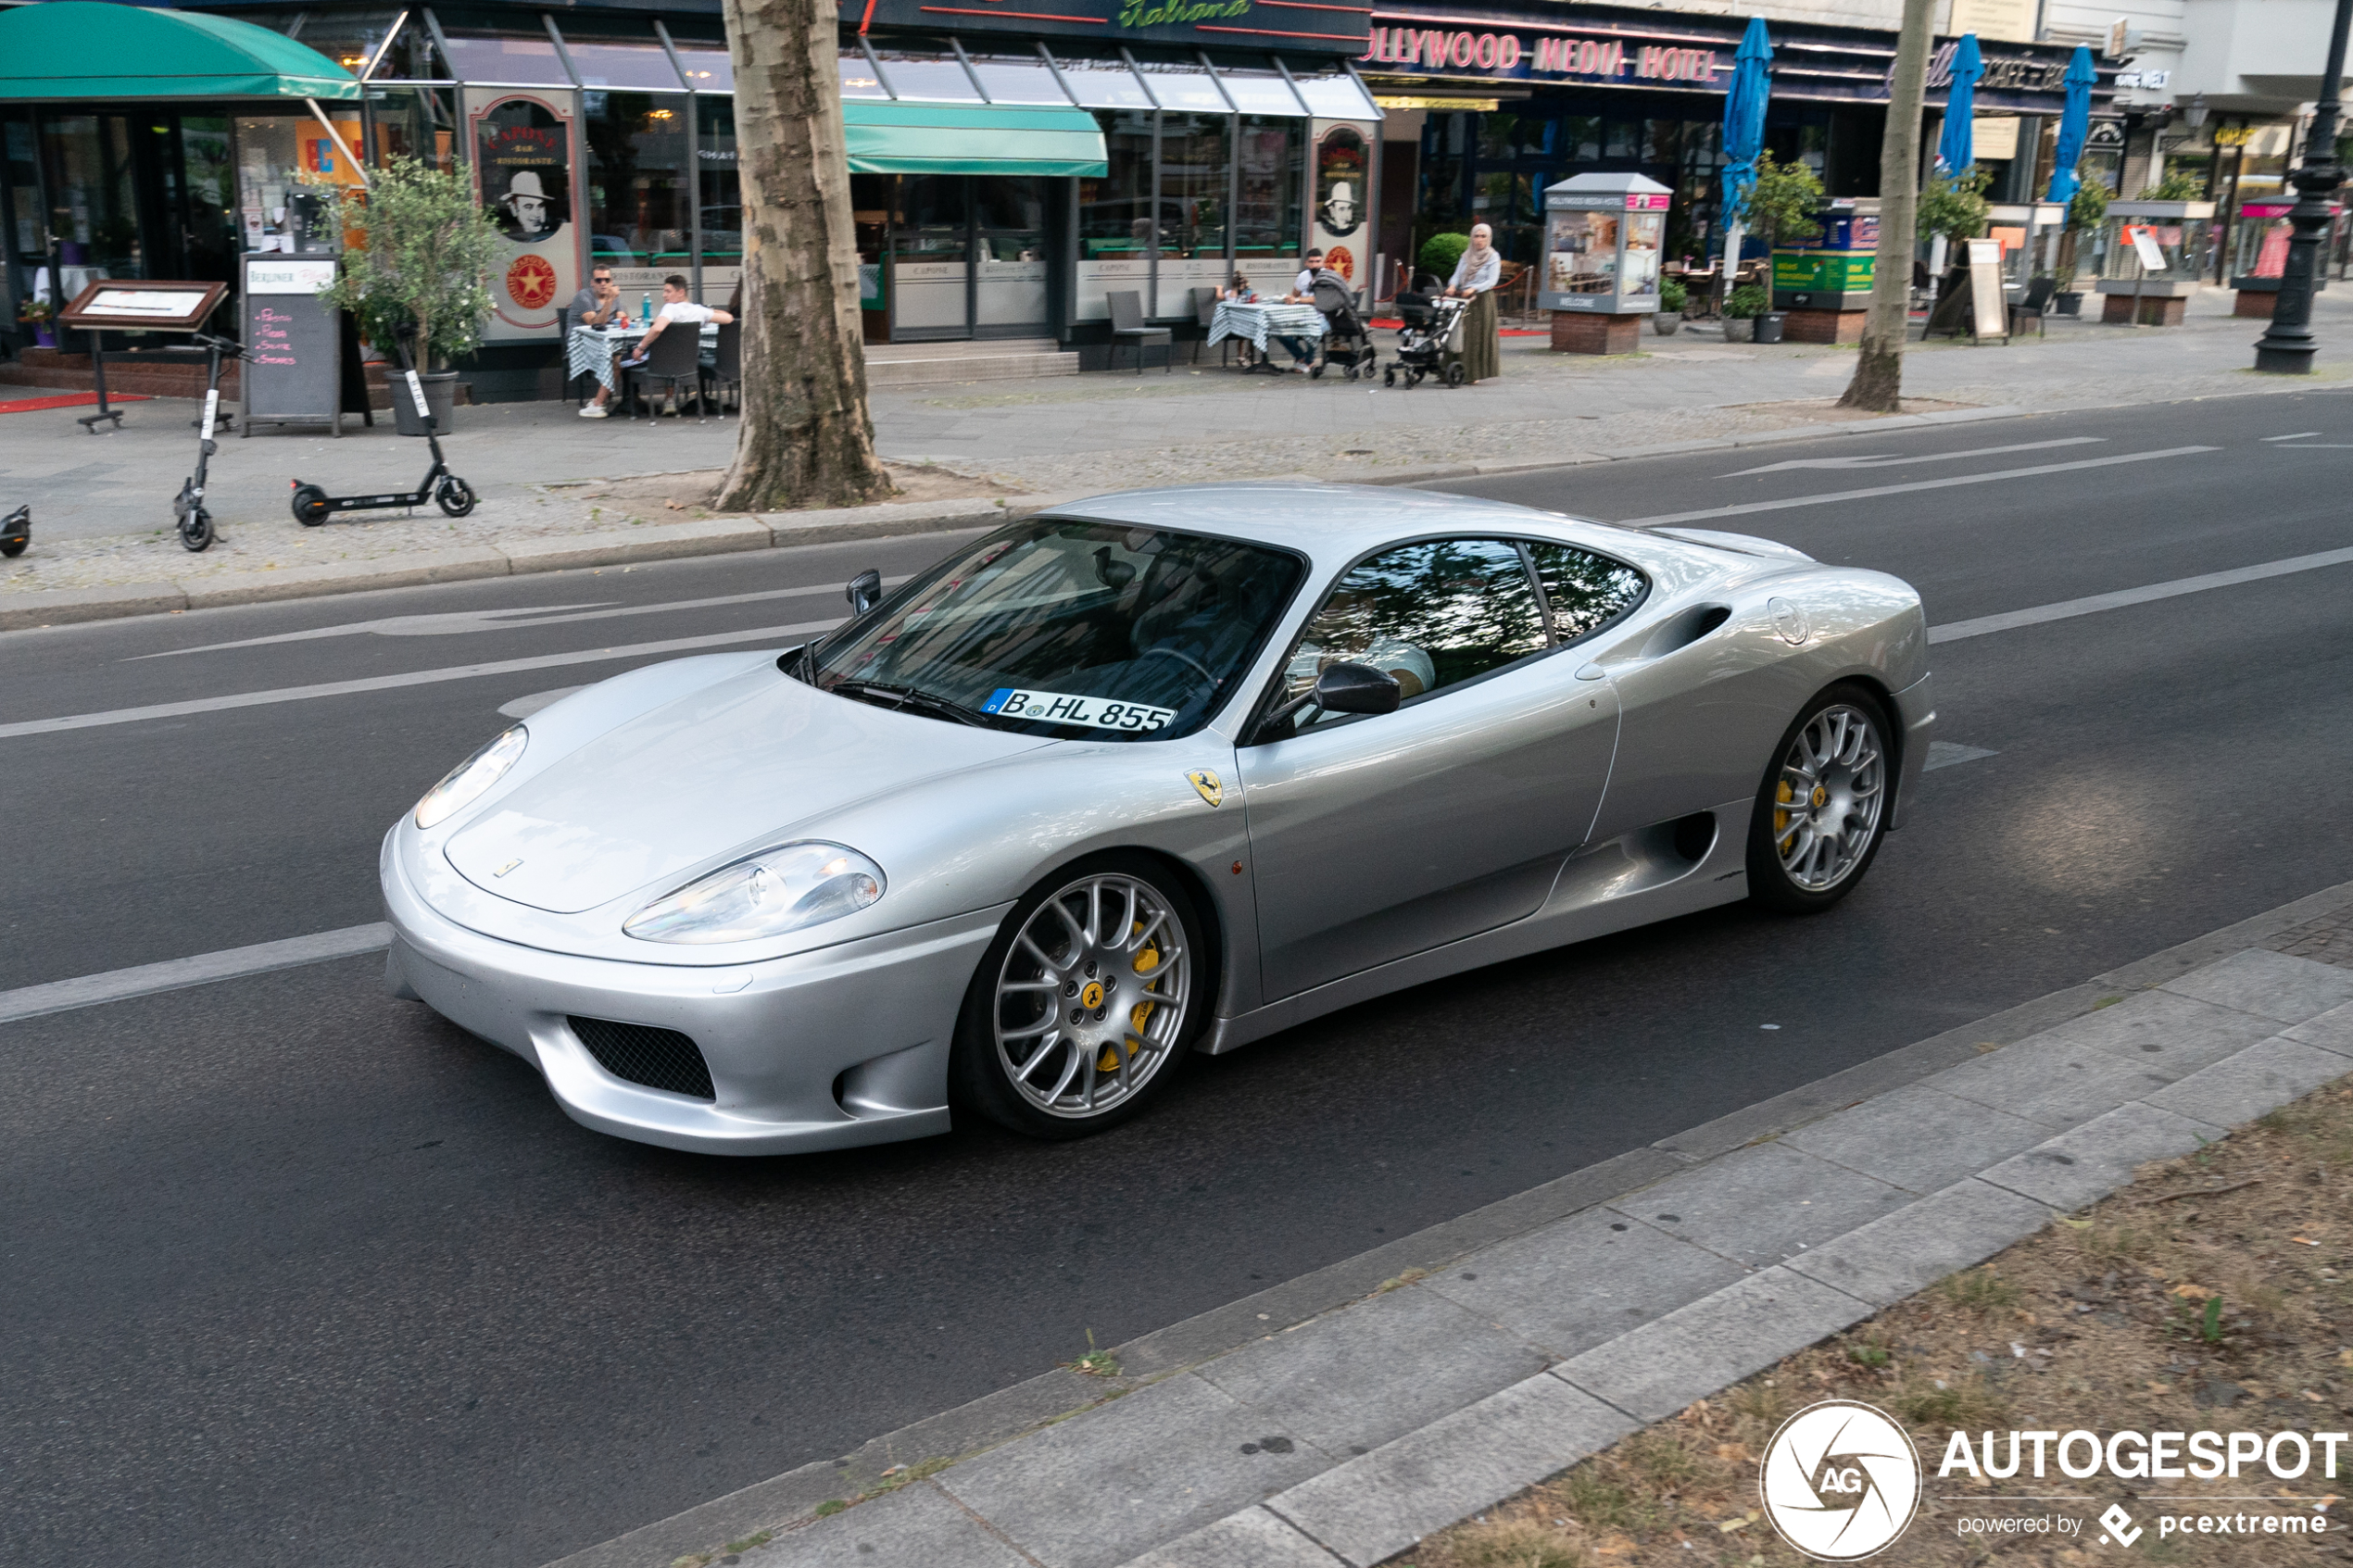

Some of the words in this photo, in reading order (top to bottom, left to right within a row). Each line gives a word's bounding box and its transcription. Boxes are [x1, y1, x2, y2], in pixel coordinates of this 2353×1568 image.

[1358, 27, 1521, 69] OLLYWOOD
[1531, 38, 1625, 76] MEDIA
[1634, 45, 1719, 83] HOTEL
[487, 126, 558, 152] CAPONE
[1584, 197, 1604, 206] MEDIA
[1559, 297, 1595, 307] WELCOME
[1001, 692, 1027, 714] B
[1045, 696, 1090, 722] HL
[1098, 703, 1172, 732] 855
